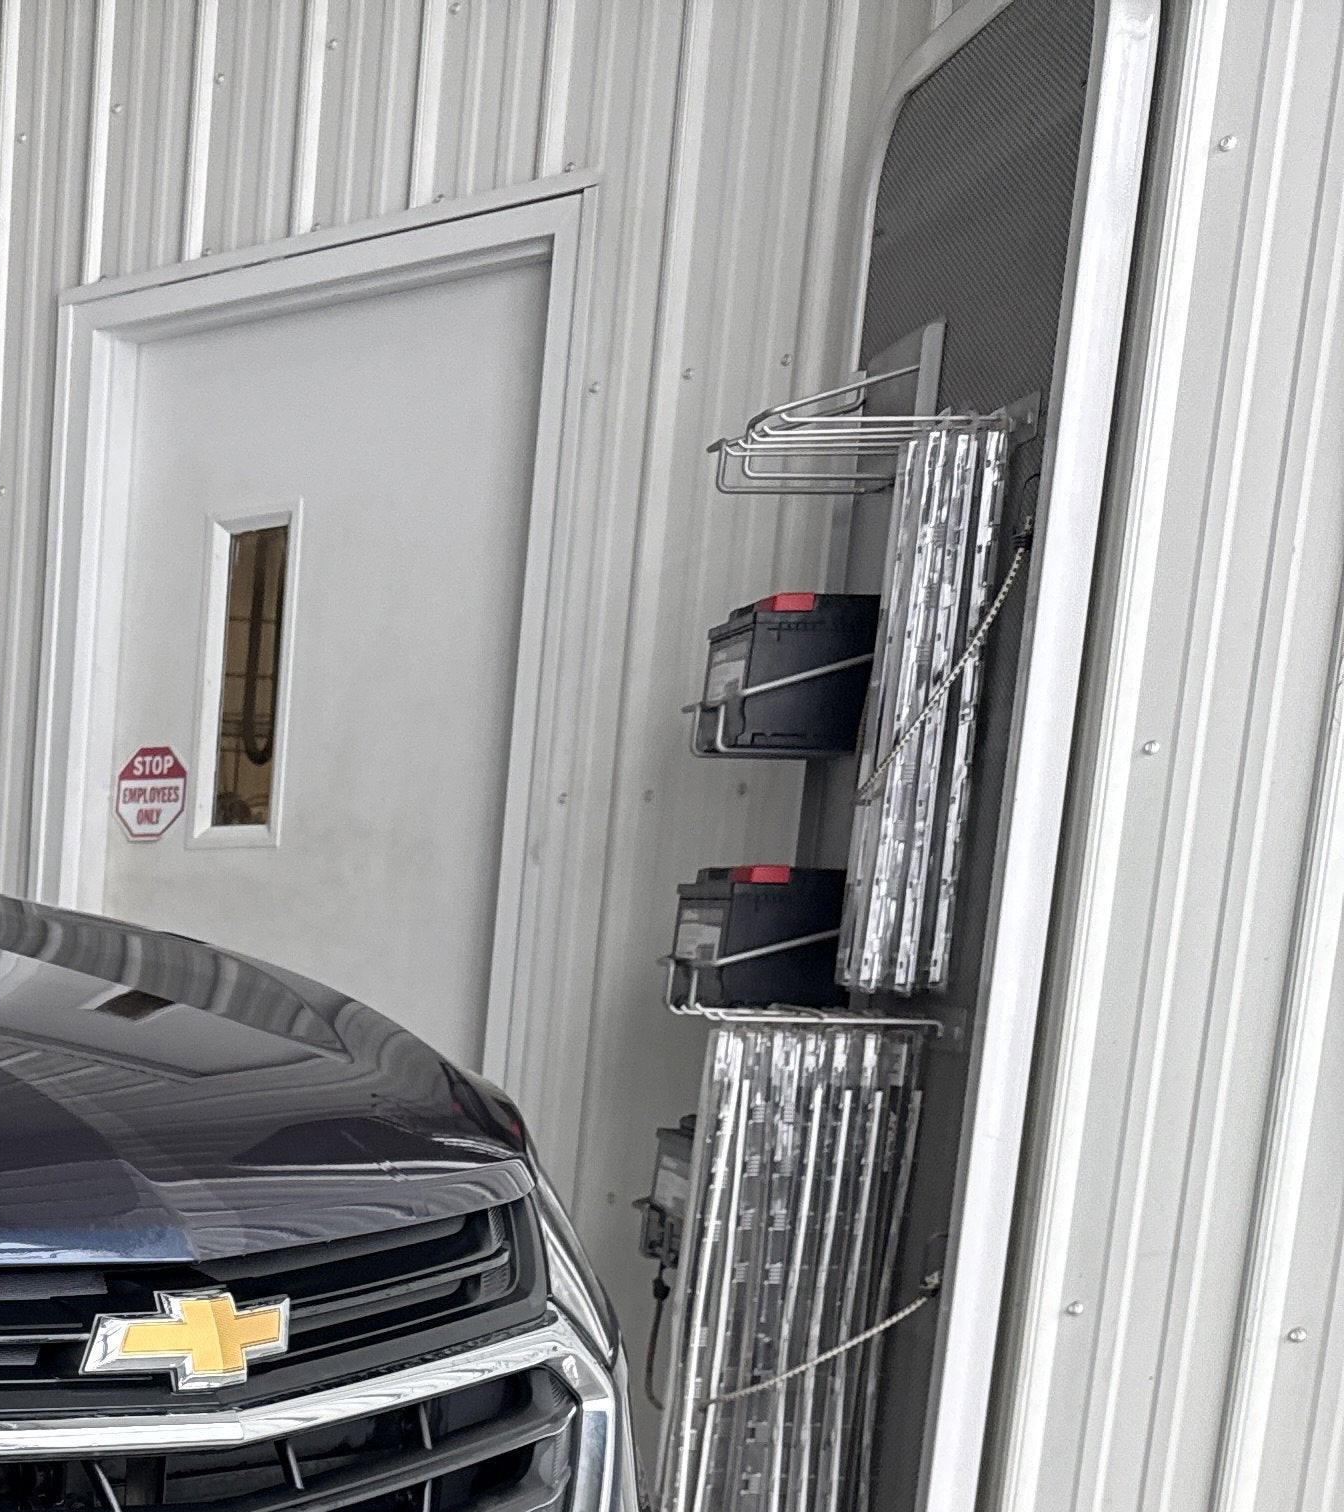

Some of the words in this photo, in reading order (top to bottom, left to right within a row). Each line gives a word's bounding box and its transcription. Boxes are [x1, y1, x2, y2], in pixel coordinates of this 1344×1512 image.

[133, 755, 175, 776] STOP
[123, 786, 180, 804] EMPLOYEES
[137, 808, 162, 825] ONLY
